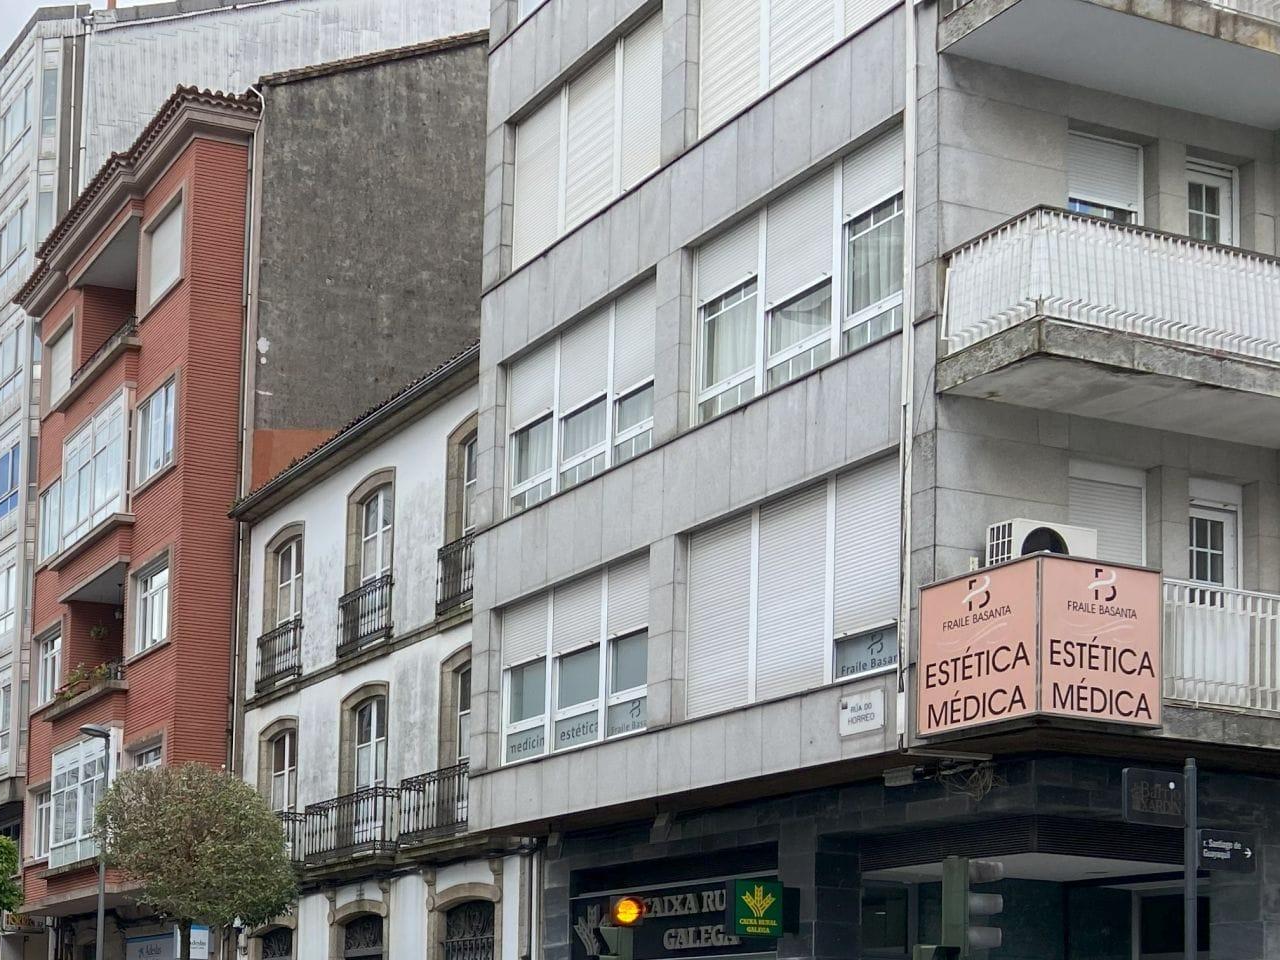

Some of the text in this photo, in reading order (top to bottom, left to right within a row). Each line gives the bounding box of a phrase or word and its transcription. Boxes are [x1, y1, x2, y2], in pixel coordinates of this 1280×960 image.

[942, 605, 1012, 632] FRAILE BASANTA
[1067, 601, 1138, 620] FRAILE BASANTA
[925, 641, 1031, 689] ESTÉTICA
[1049, 636, 1155, 678] ESTÉTICA
[841, 660, 868, 675] Fraile
[864, 702, 873, 711] DO
[927, 684, 1027, 729] MÉDICA
[1052, 677, 1152, 720] MÉDICA
[1202, 848, 1231, 859] Guayaquil
[1208, 838, 1234, 851] Santiago
[1233, 841, 1242, 850] de
[746, 926, 770, 934] GALEGA
